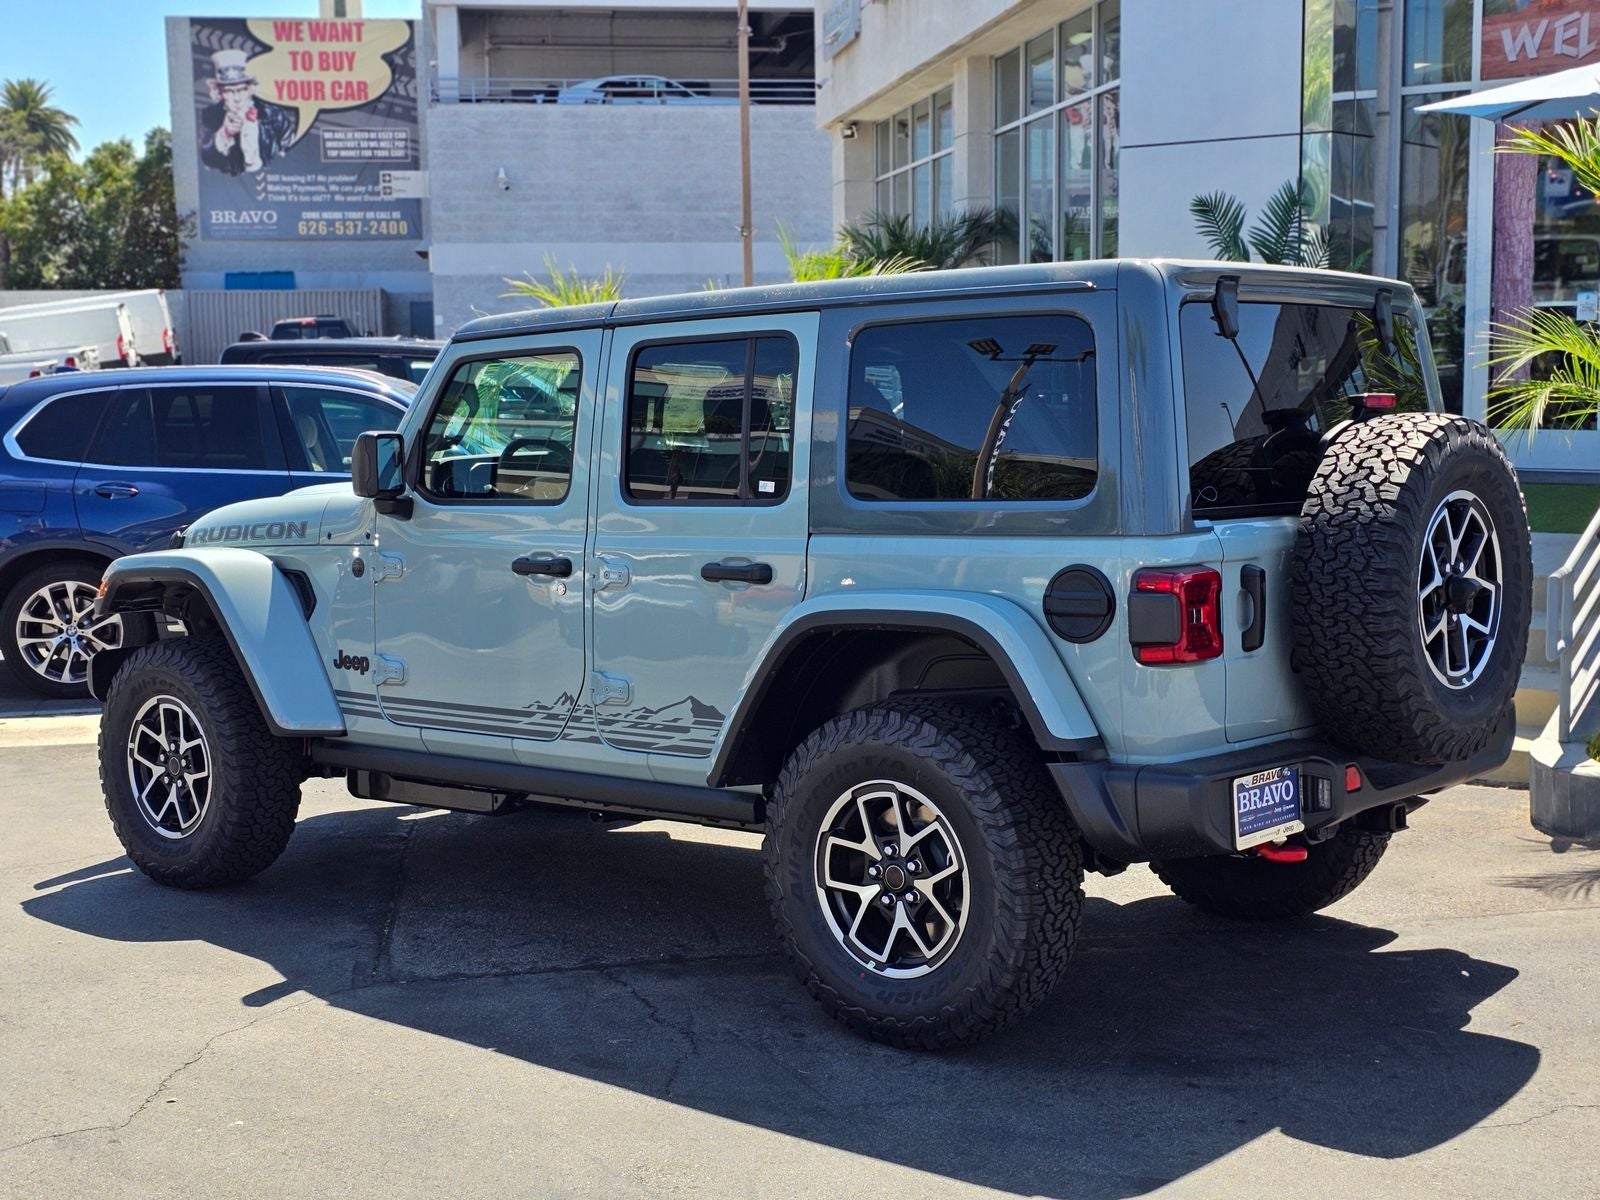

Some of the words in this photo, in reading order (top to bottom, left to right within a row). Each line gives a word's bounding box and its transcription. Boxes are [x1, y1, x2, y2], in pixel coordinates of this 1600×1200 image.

[273, 21, 304, 42] WE
[308, 21, 364, 42] WANT
[1501, 8, 1598, 62] WEL
[289, 51, 314, 71] TO
[318, 51, 356, 71] BUY
[274, 80, 326, 100] YOUR
[330, 80, 369, 100] CAR
[210, 210, 278, 223] BRAVO
[298, 220, 408, 235] 626-537-2400
[191, 521, 308, 543] RUBICON
[333, 649, 370, 675] Jeep
[1252, 768, 1283, 785] BRAVO
[1238, 780, 1294, 813] BRAVO
